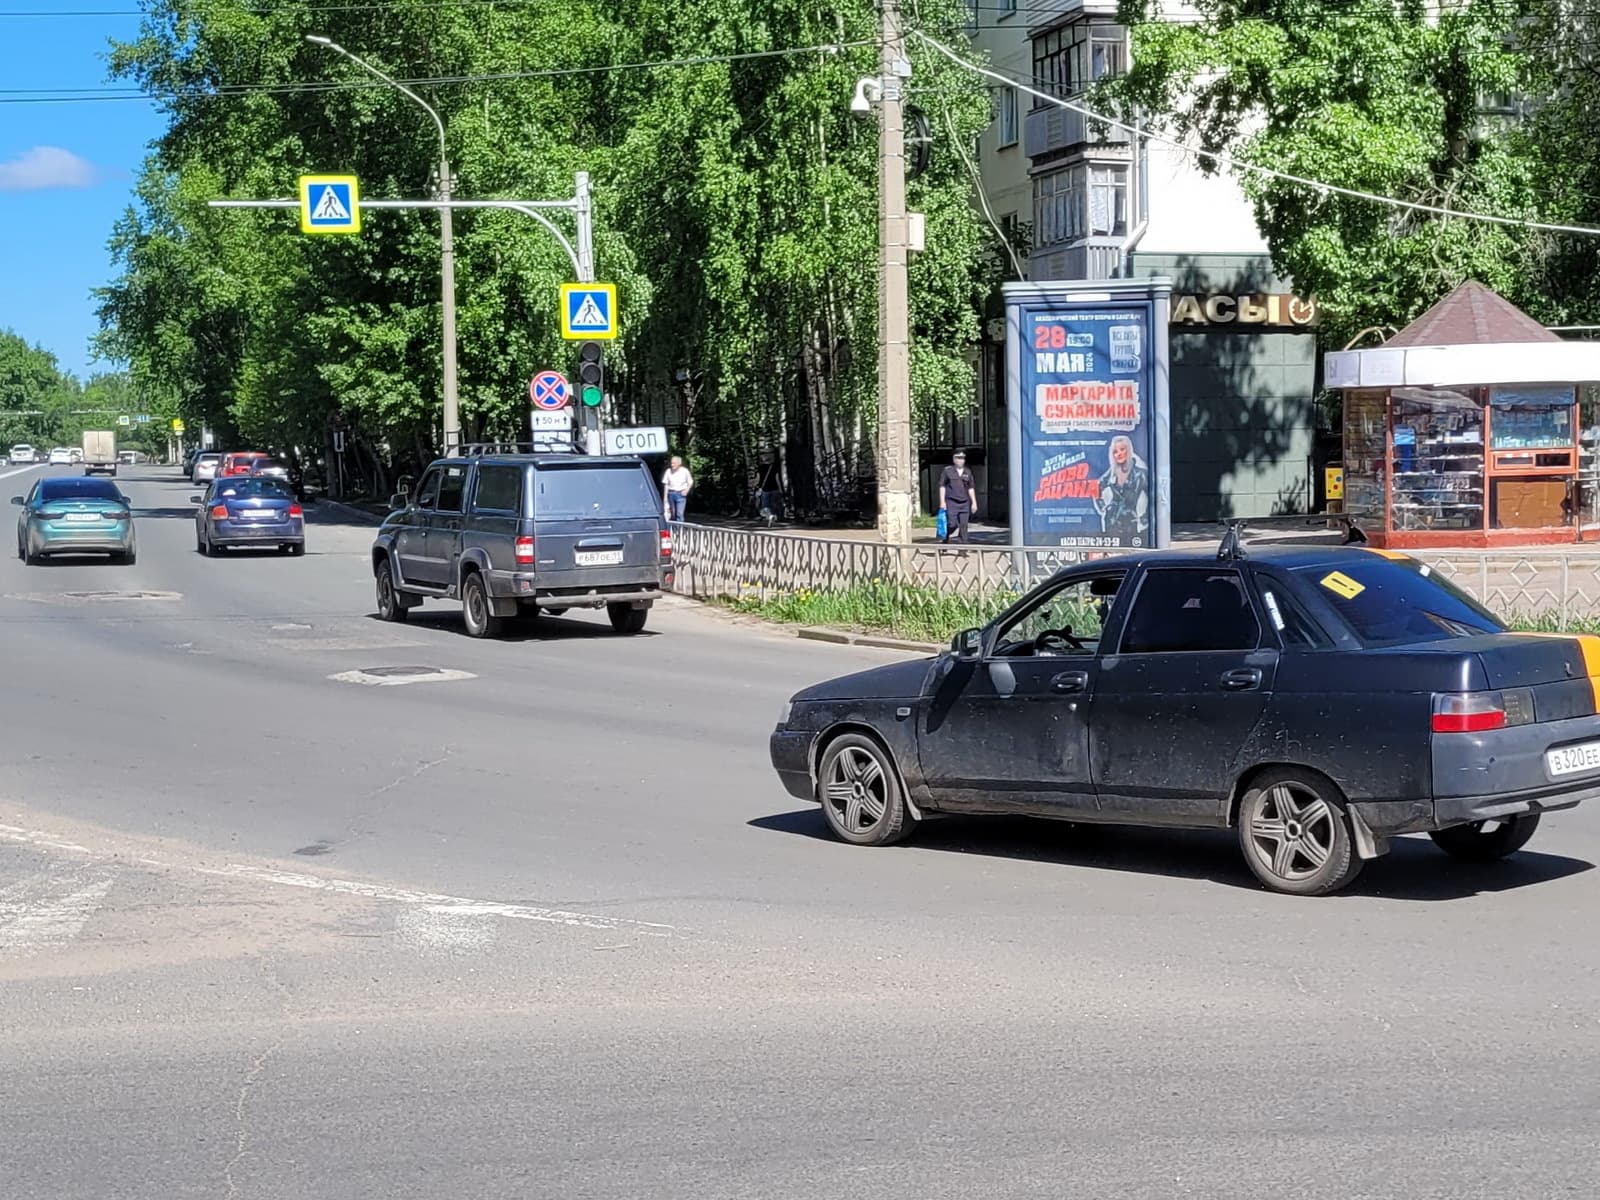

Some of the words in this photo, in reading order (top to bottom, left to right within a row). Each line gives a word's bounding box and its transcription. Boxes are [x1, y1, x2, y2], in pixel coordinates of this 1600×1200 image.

[1167, 295, 1281, 323] АСЫ
[1035, 325, 1065, 348] 28
[1036, 352, 1085, 373] МАЯ
[1046, 385, 1133, 401] МАРГАРИТА
[543, 416, 553, 425] 50
[615, 433, 657, 449] СТОП
[1553, 747, 1598, 771] В320ЕЕ
